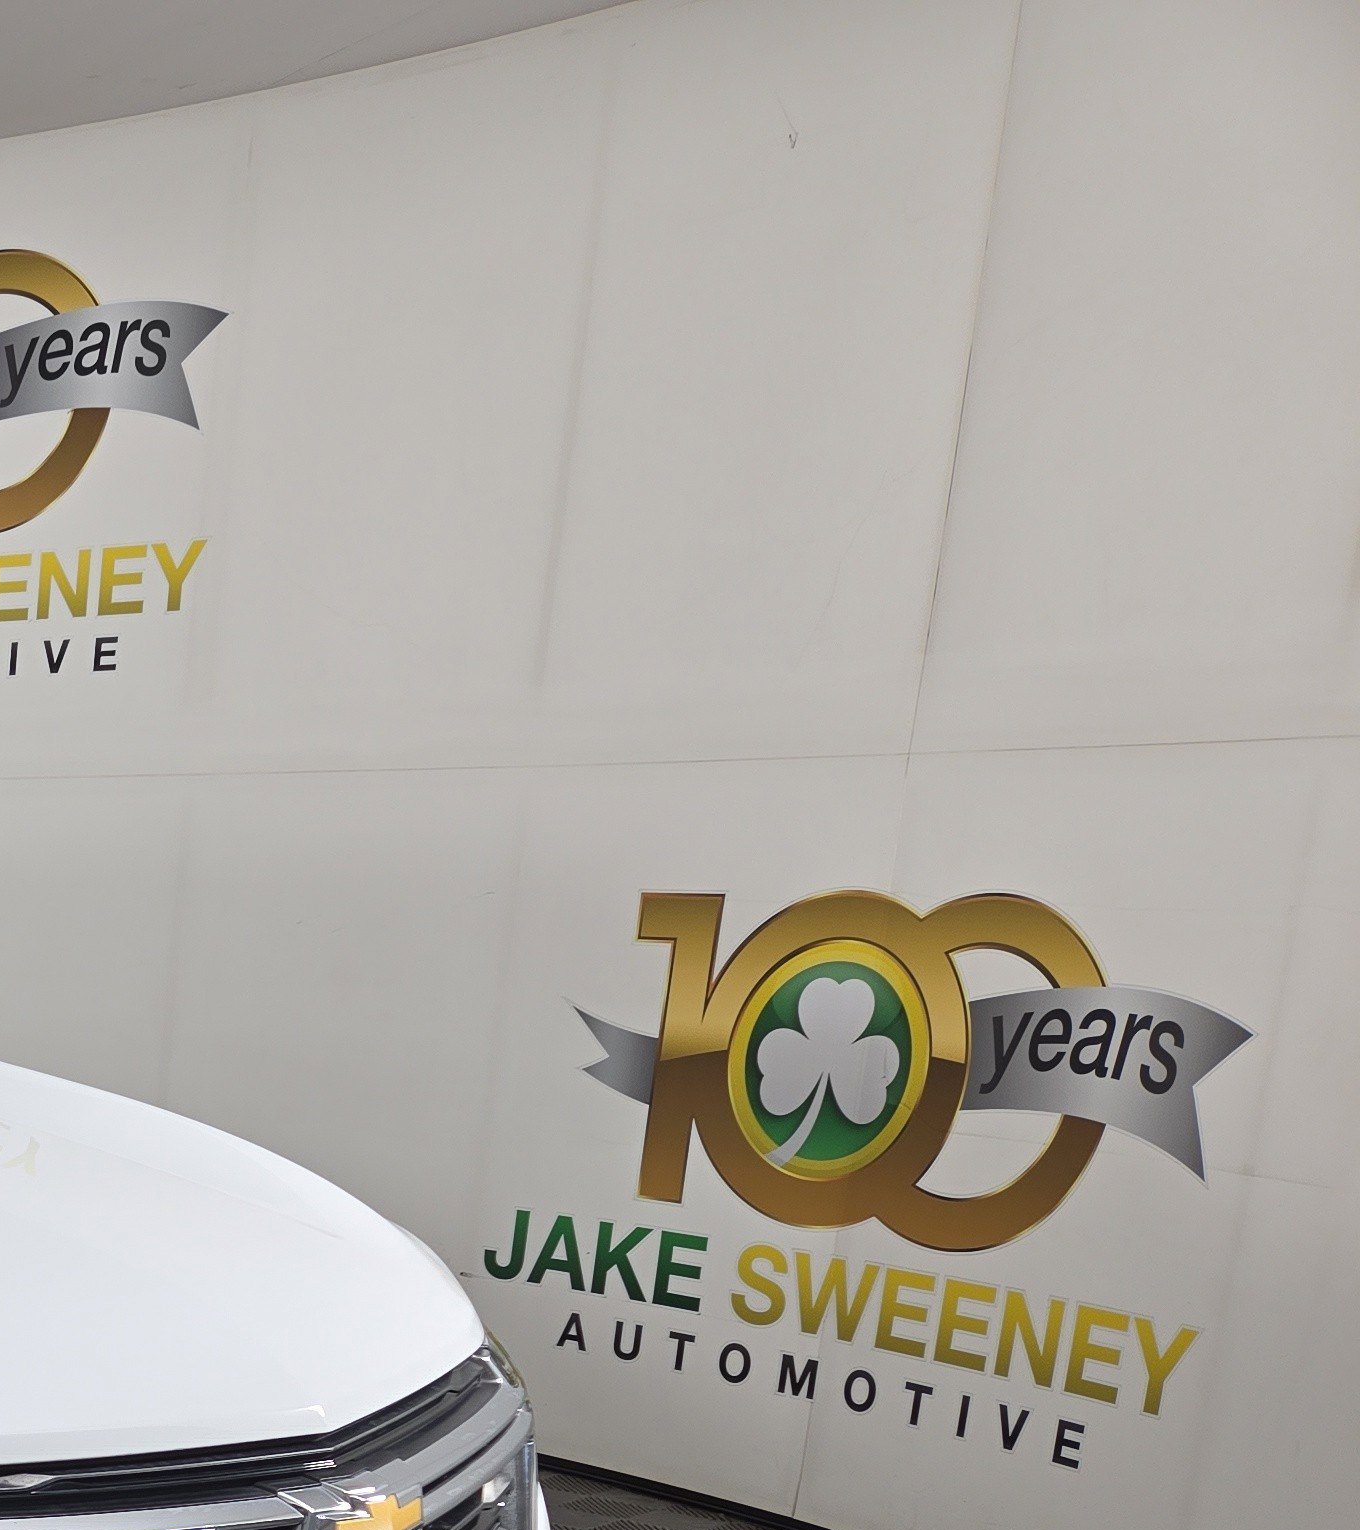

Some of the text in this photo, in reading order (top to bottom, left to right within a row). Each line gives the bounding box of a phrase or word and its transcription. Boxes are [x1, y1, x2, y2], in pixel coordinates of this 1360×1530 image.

[0, 317, 170, 410] years
[636, 890, 1185, 1253] 100 years
[484, 1210, 1198, 1417] JAKE SWEENEY
[556, 1311, 1086, 1470] AUTOMOTIVE
